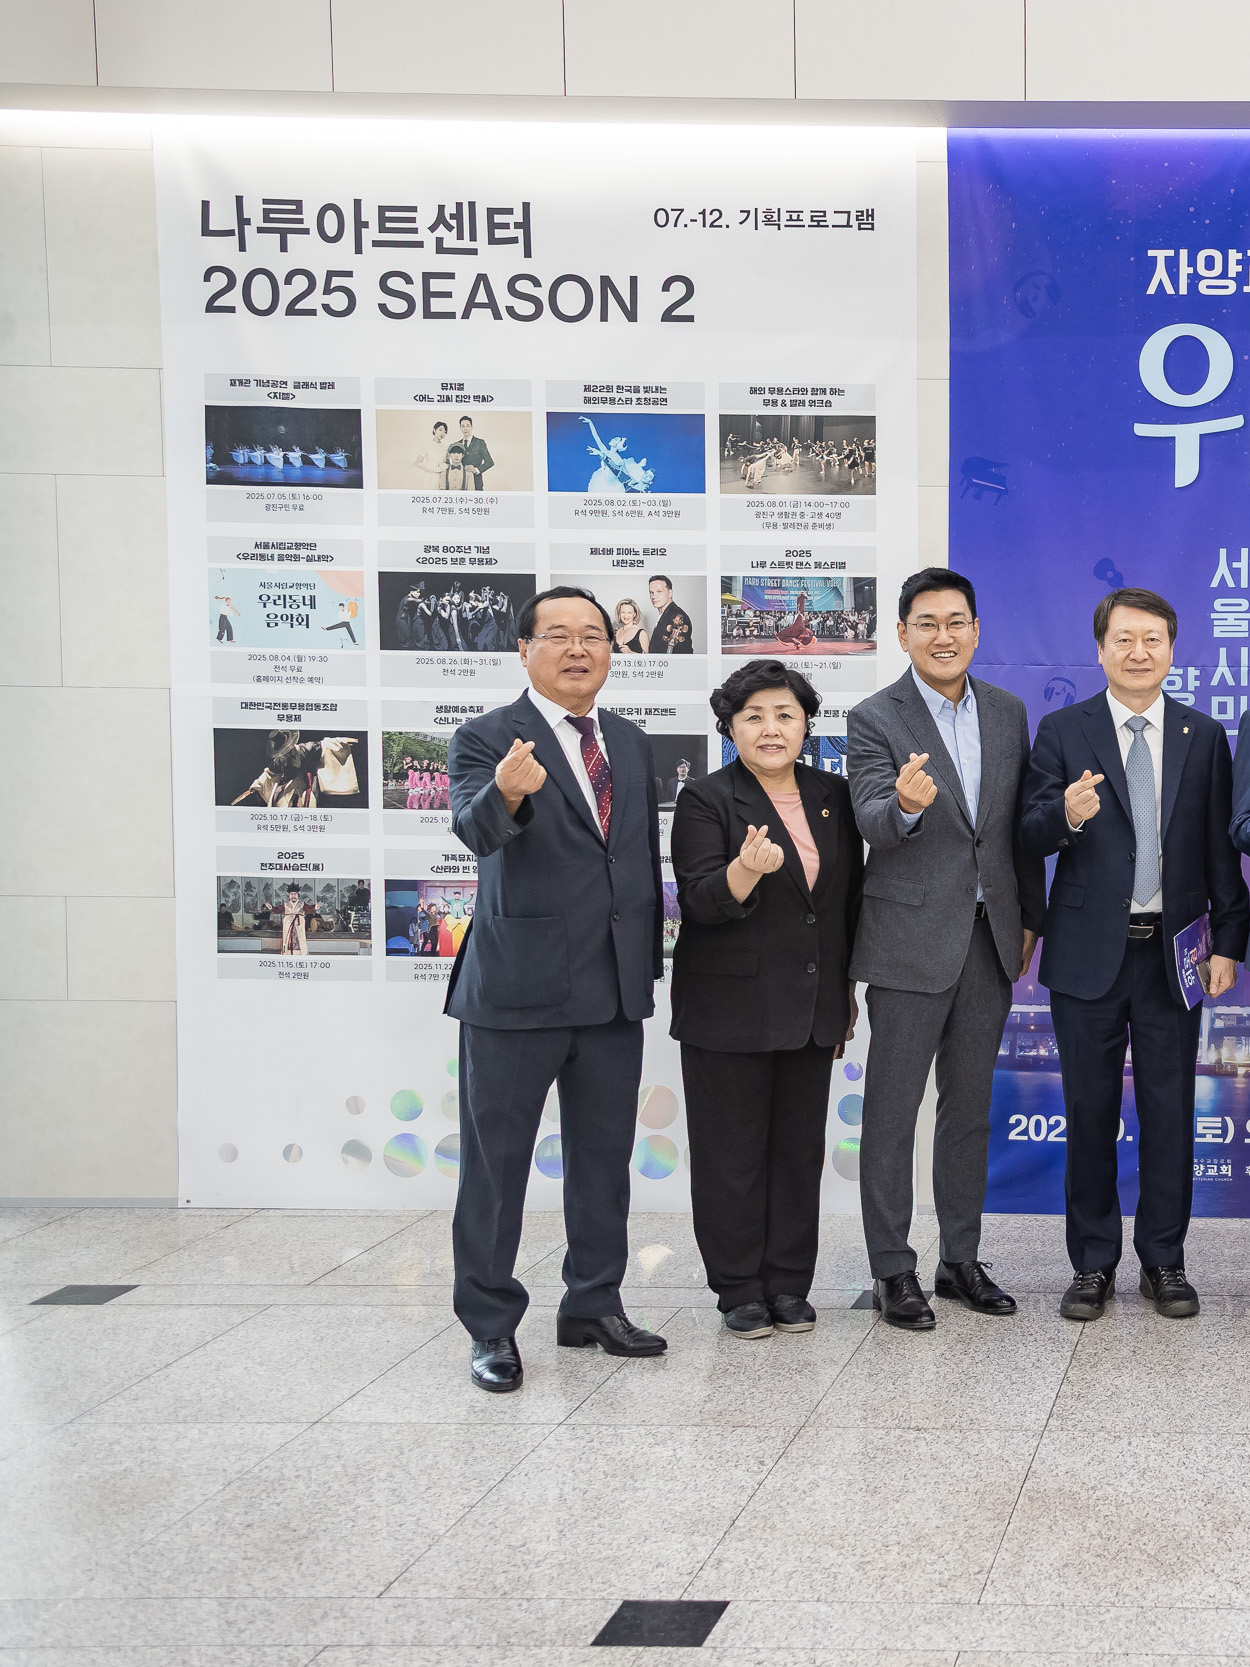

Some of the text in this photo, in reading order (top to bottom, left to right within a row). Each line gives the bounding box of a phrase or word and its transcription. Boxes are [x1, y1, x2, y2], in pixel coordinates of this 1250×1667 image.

[654, 208, 875, 231] 07.-12. 기획프로그램
[201, 195, 532, 258] 나루아트센터
[203, 265, 695, 324] 2025 SEASON 2
[253, 379, 288, 388] 기념공연
[293, 381, 317, 389] 클래식
[441, 382, 464, 391] 뮤지컬
[583, 385, 667, 394] 제22회 한국을 빛내는
[750, 387, 845, 396] 해외 무용스타와 함께 하는
[583, 396, 668, 406] 해외무용스타 초청공연
[763, 399, 778, 407] 무용
[781, 399, 787, 407] &
[790, 399, 805, 408] 발레
[575, 509, 587, 517] R석
[648, 510, 660, 518] A석
[662, 510, 680, 518] 3만원
[777, 511, 797, 519] 생활권
[825, 511, 842, 519] 40명
[254, 541, 317, 551] 서울시립교향악단
[423, 545, 490, 554] 광복 80주년 기념
[590, 547, 667, 556] 제네바 피아노 트리오
[785, 550, 812, 558] 2025
[236, 552, 334, 563] <우리동네 음악회-실내악>
[416, 557, 498, 566] <2025 보훈 무용제>
[612, 559, 644, 568] 내한공연
[751, 561, 846, 570] 나루 스트릿 댄스 페스티벌
[761, 579, 780, 587] STREET
[257, 594, 316, 610] 우리동네
[265, 613, 310, 628] 음악회
[458, 669, 476, 677] 2만원
[252, 675, 323, 684] (홈페이지 선착순 예약)
[645, 707, 676, 716] 재즈밴드
[277, 714, 302, 722] 무용제
[278, 971, 290, 979] 전석
